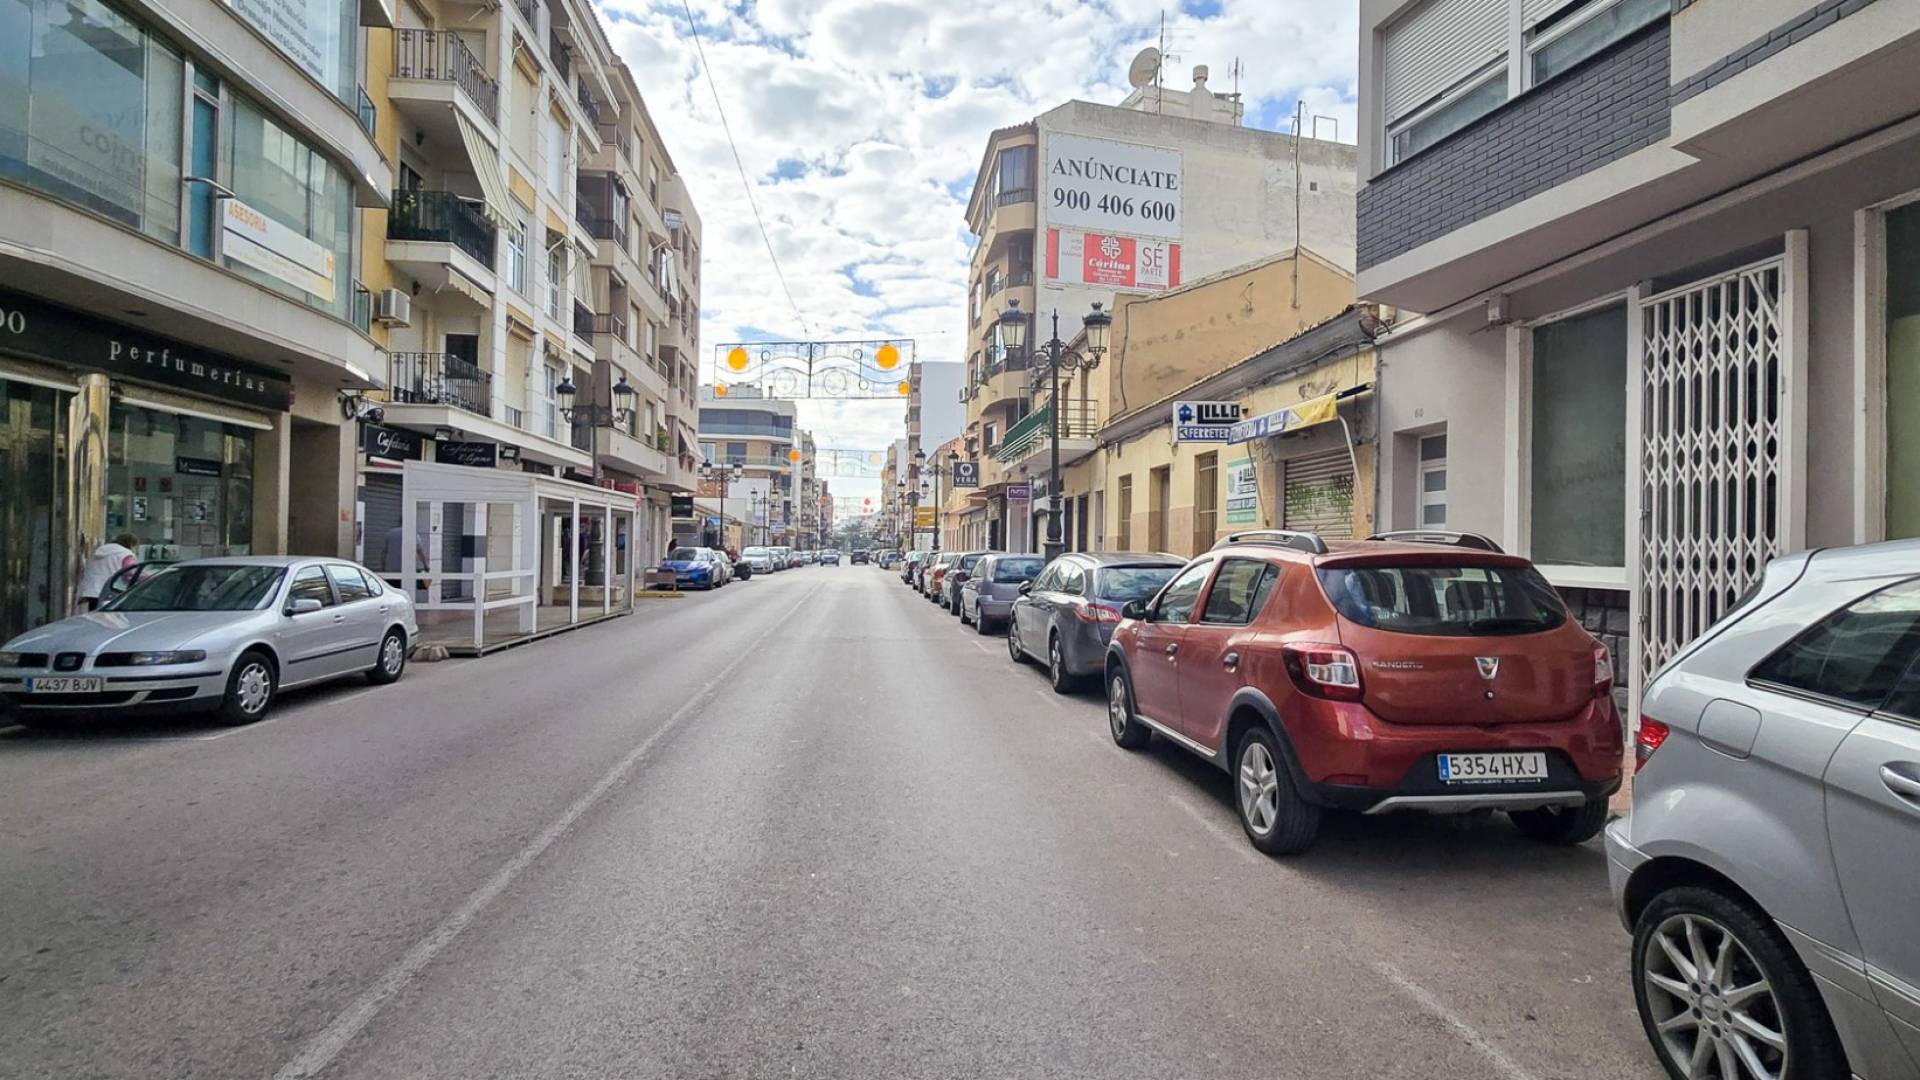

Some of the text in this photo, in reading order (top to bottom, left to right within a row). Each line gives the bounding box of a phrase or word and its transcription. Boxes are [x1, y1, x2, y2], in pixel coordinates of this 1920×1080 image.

[1052, 157, 1178, 190] ANÚNCIATE
[1054, 187, 1175, 222] 900 406 600
[1142, 242, 1163, 269] SÉ
[1141, 267, 1163, 278] PARTE
[109, 340, 266, 393] perfumerías
[1197, 404, 1239, 424] LILLO
[35, 679, 98, 691] 4437 BJV
